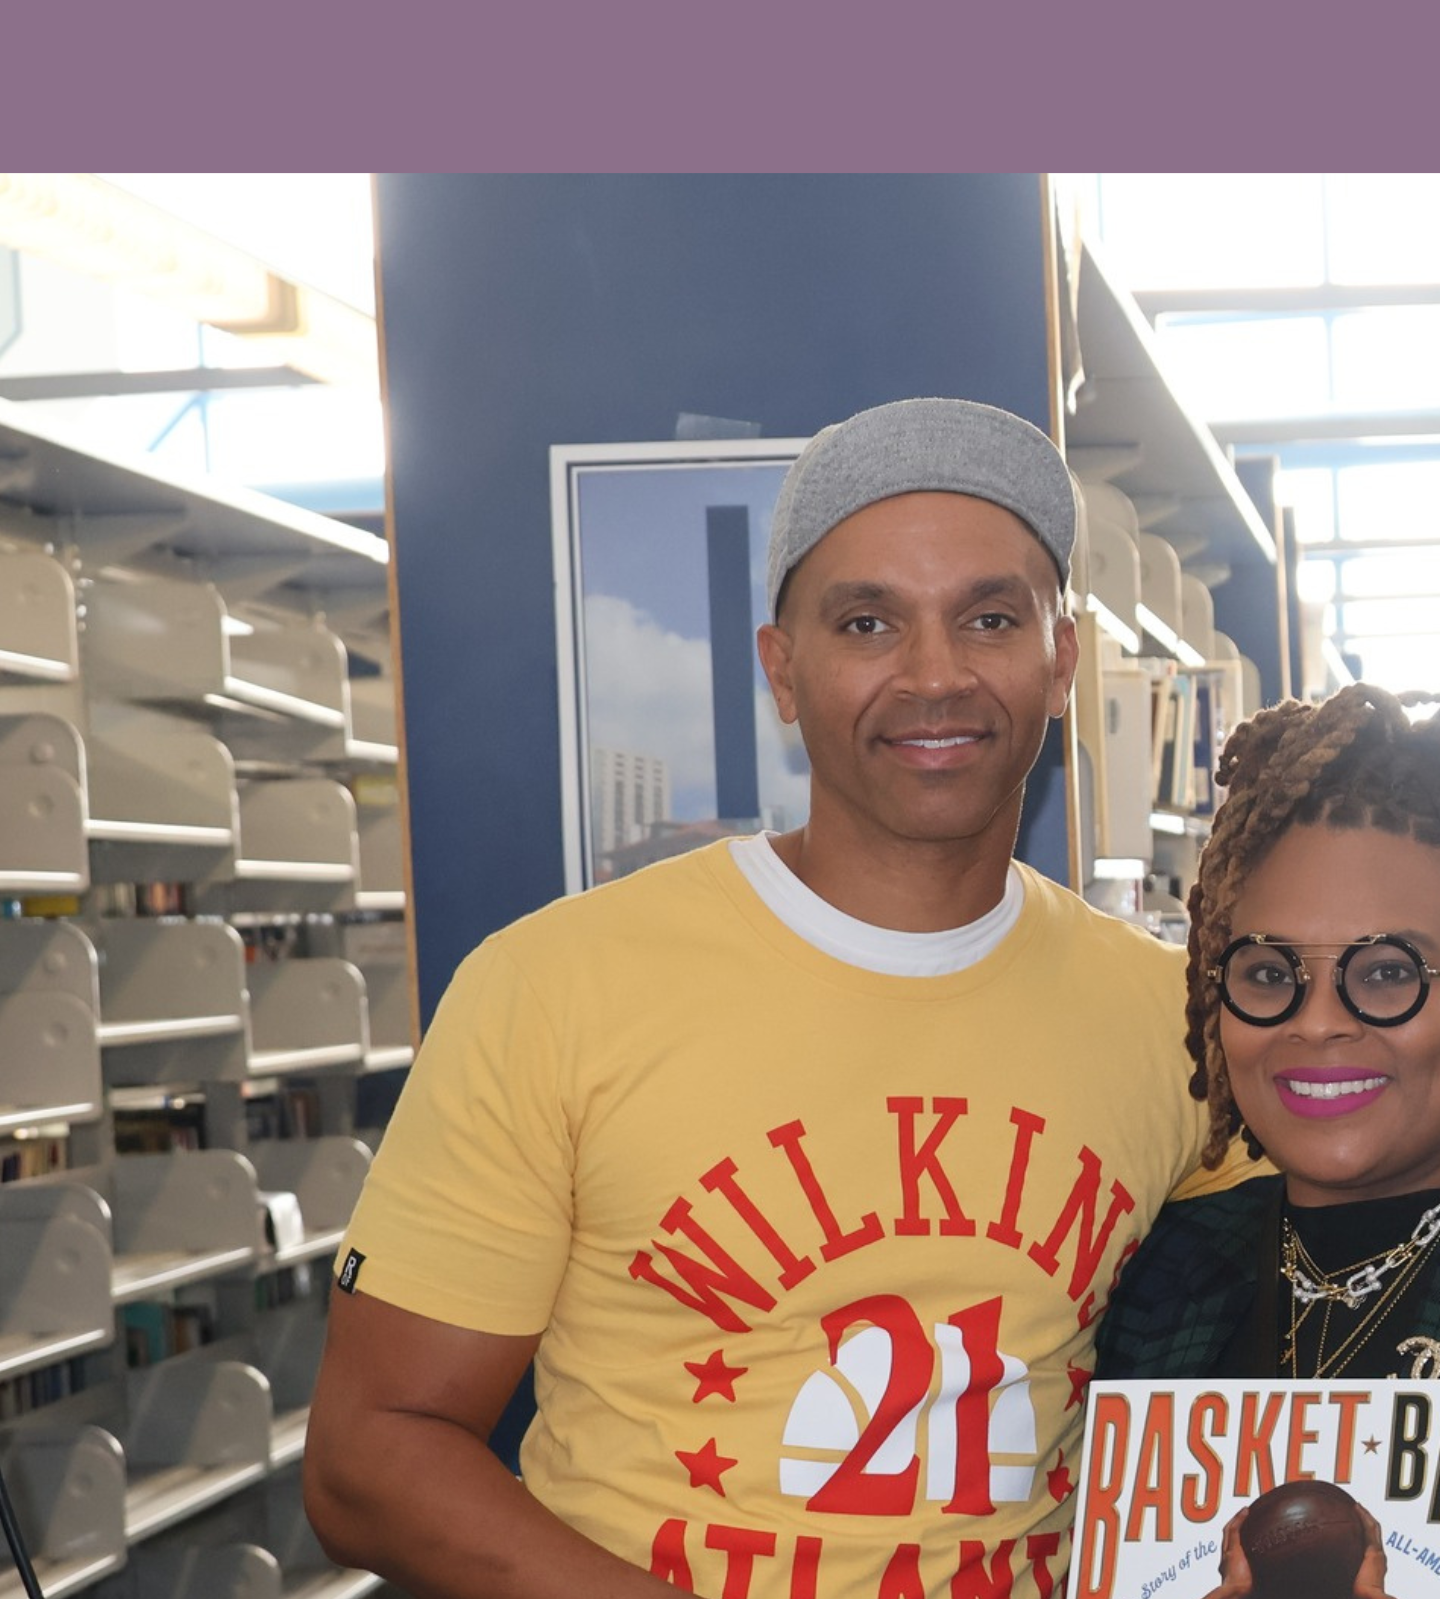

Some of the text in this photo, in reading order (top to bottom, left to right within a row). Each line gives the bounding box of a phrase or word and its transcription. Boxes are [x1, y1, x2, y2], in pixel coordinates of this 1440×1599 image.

[806, 1294, 1004, 1516] 21
[1075, 1390, 1372, 1599] BASKET
[1141, 1538, 1218, 1599] Story of the
